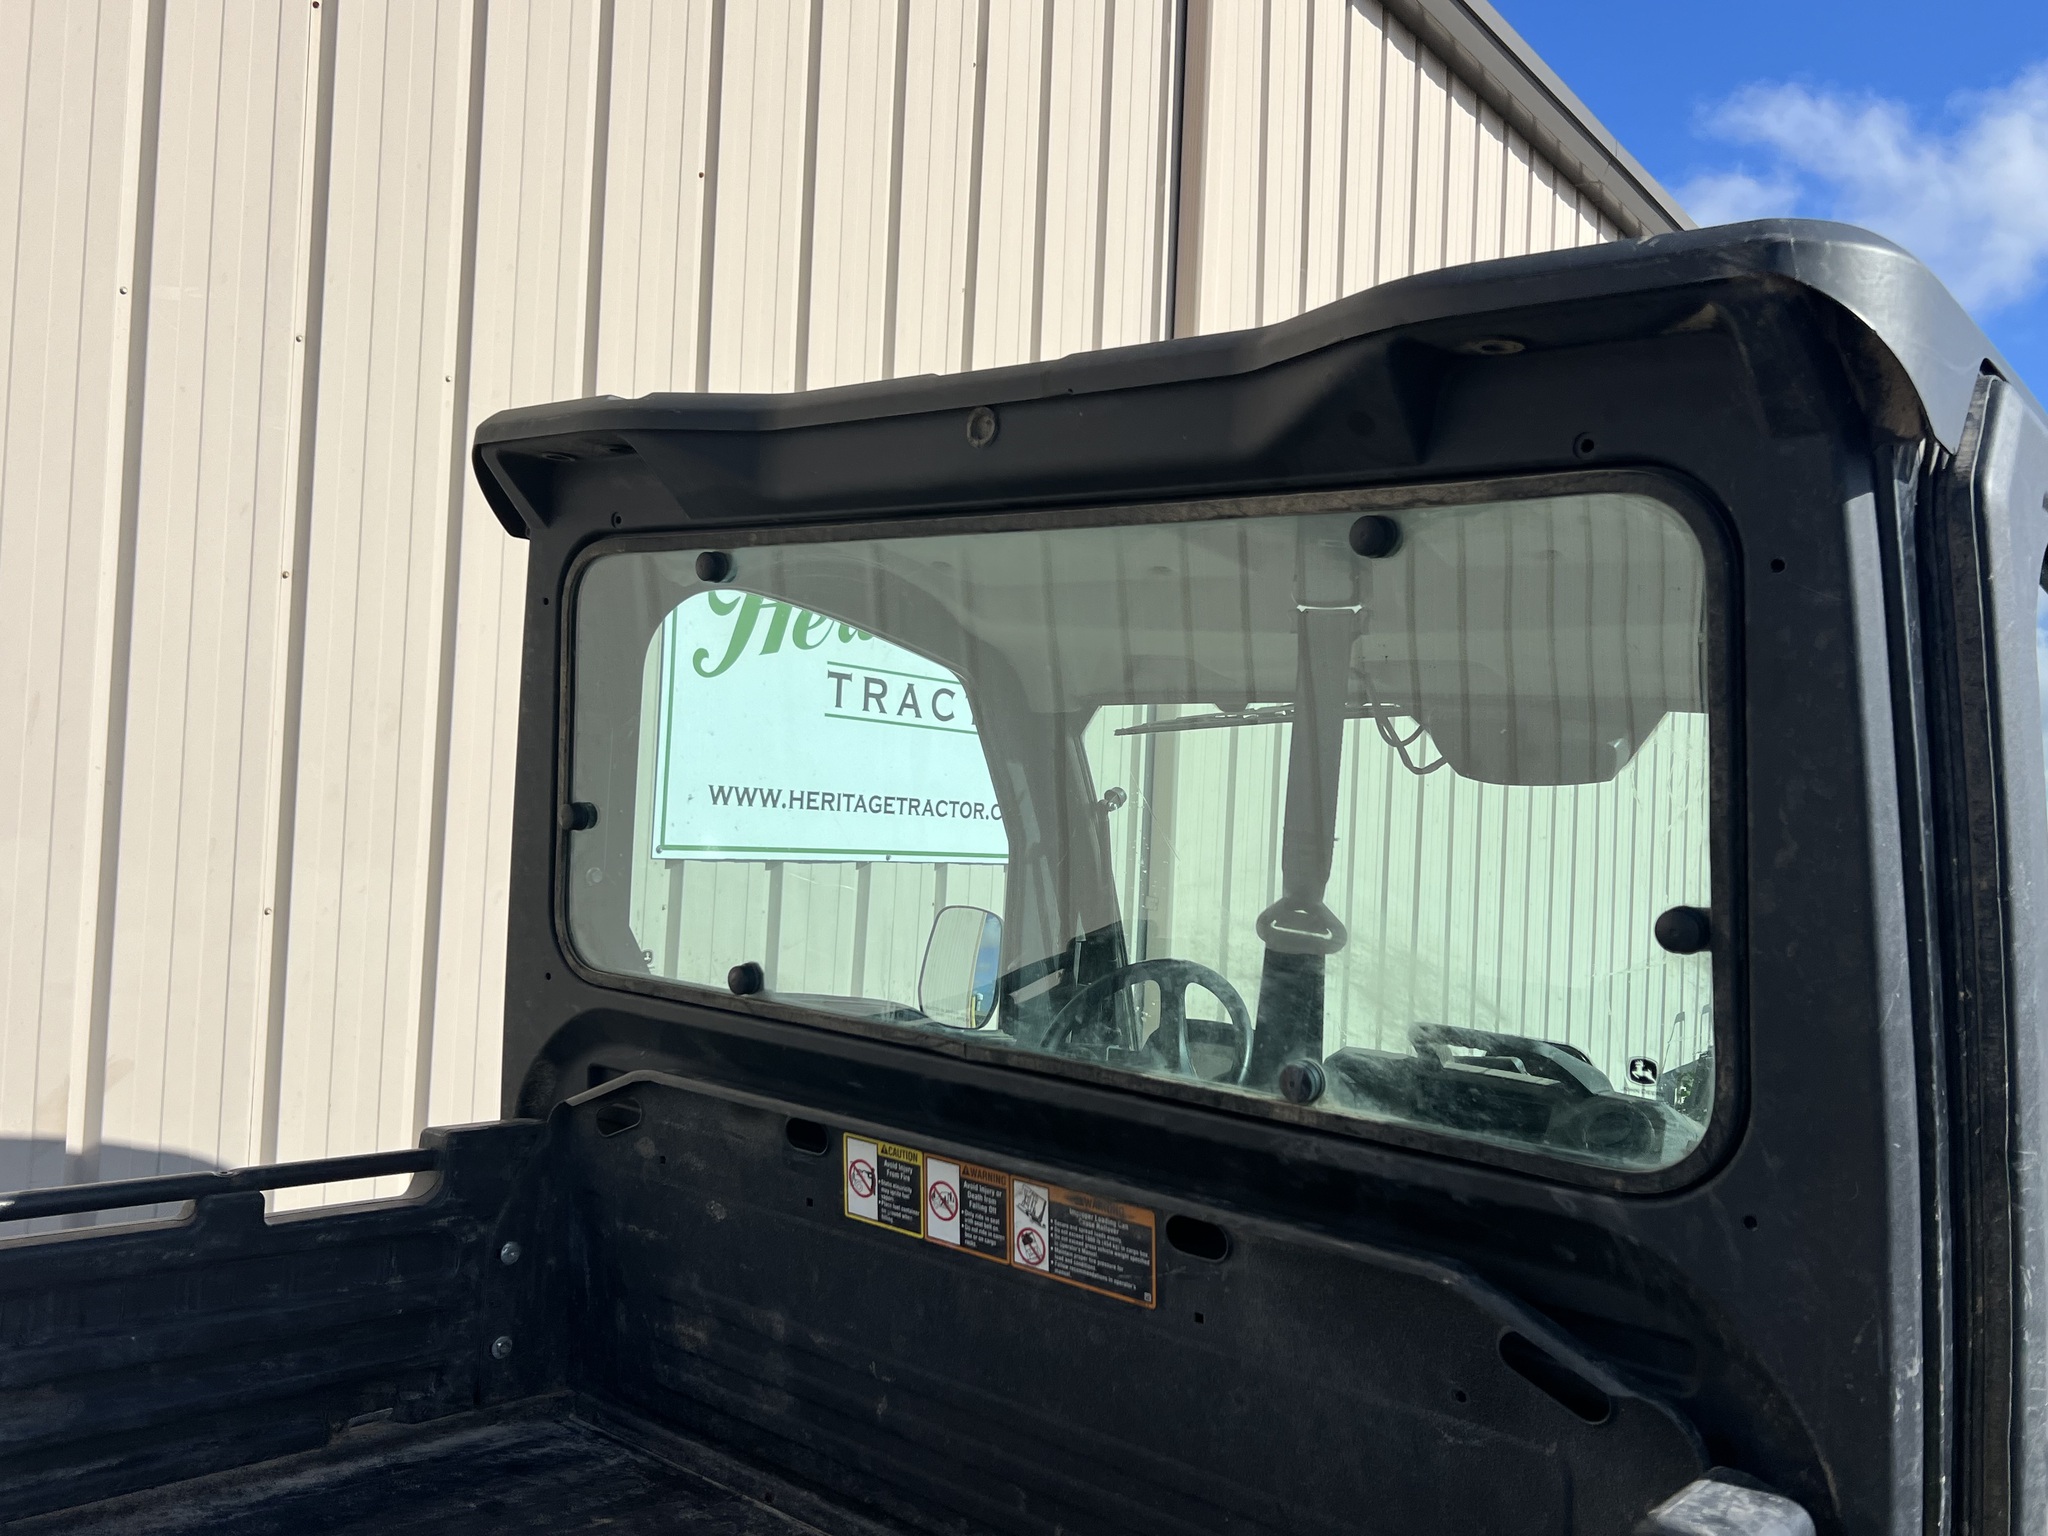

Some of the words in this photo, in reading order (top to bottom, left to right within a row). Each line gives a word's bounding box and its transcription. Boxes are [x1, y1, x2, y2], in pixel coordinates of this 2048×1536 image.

[828, 670, 977, 725] TRAC
[889, 1147, 917, 1162] CAUTION
[970, 1167, 1006, 1185] WARNING
[964, 1180, 978, 1189] Avoid
[979, 1185, 995, 1197] Injury
[967, 1190, 983, 1201] Death
[969, 1200, 987, 1214] Falling
[1095, 1214, 1116, 1227] Loading
